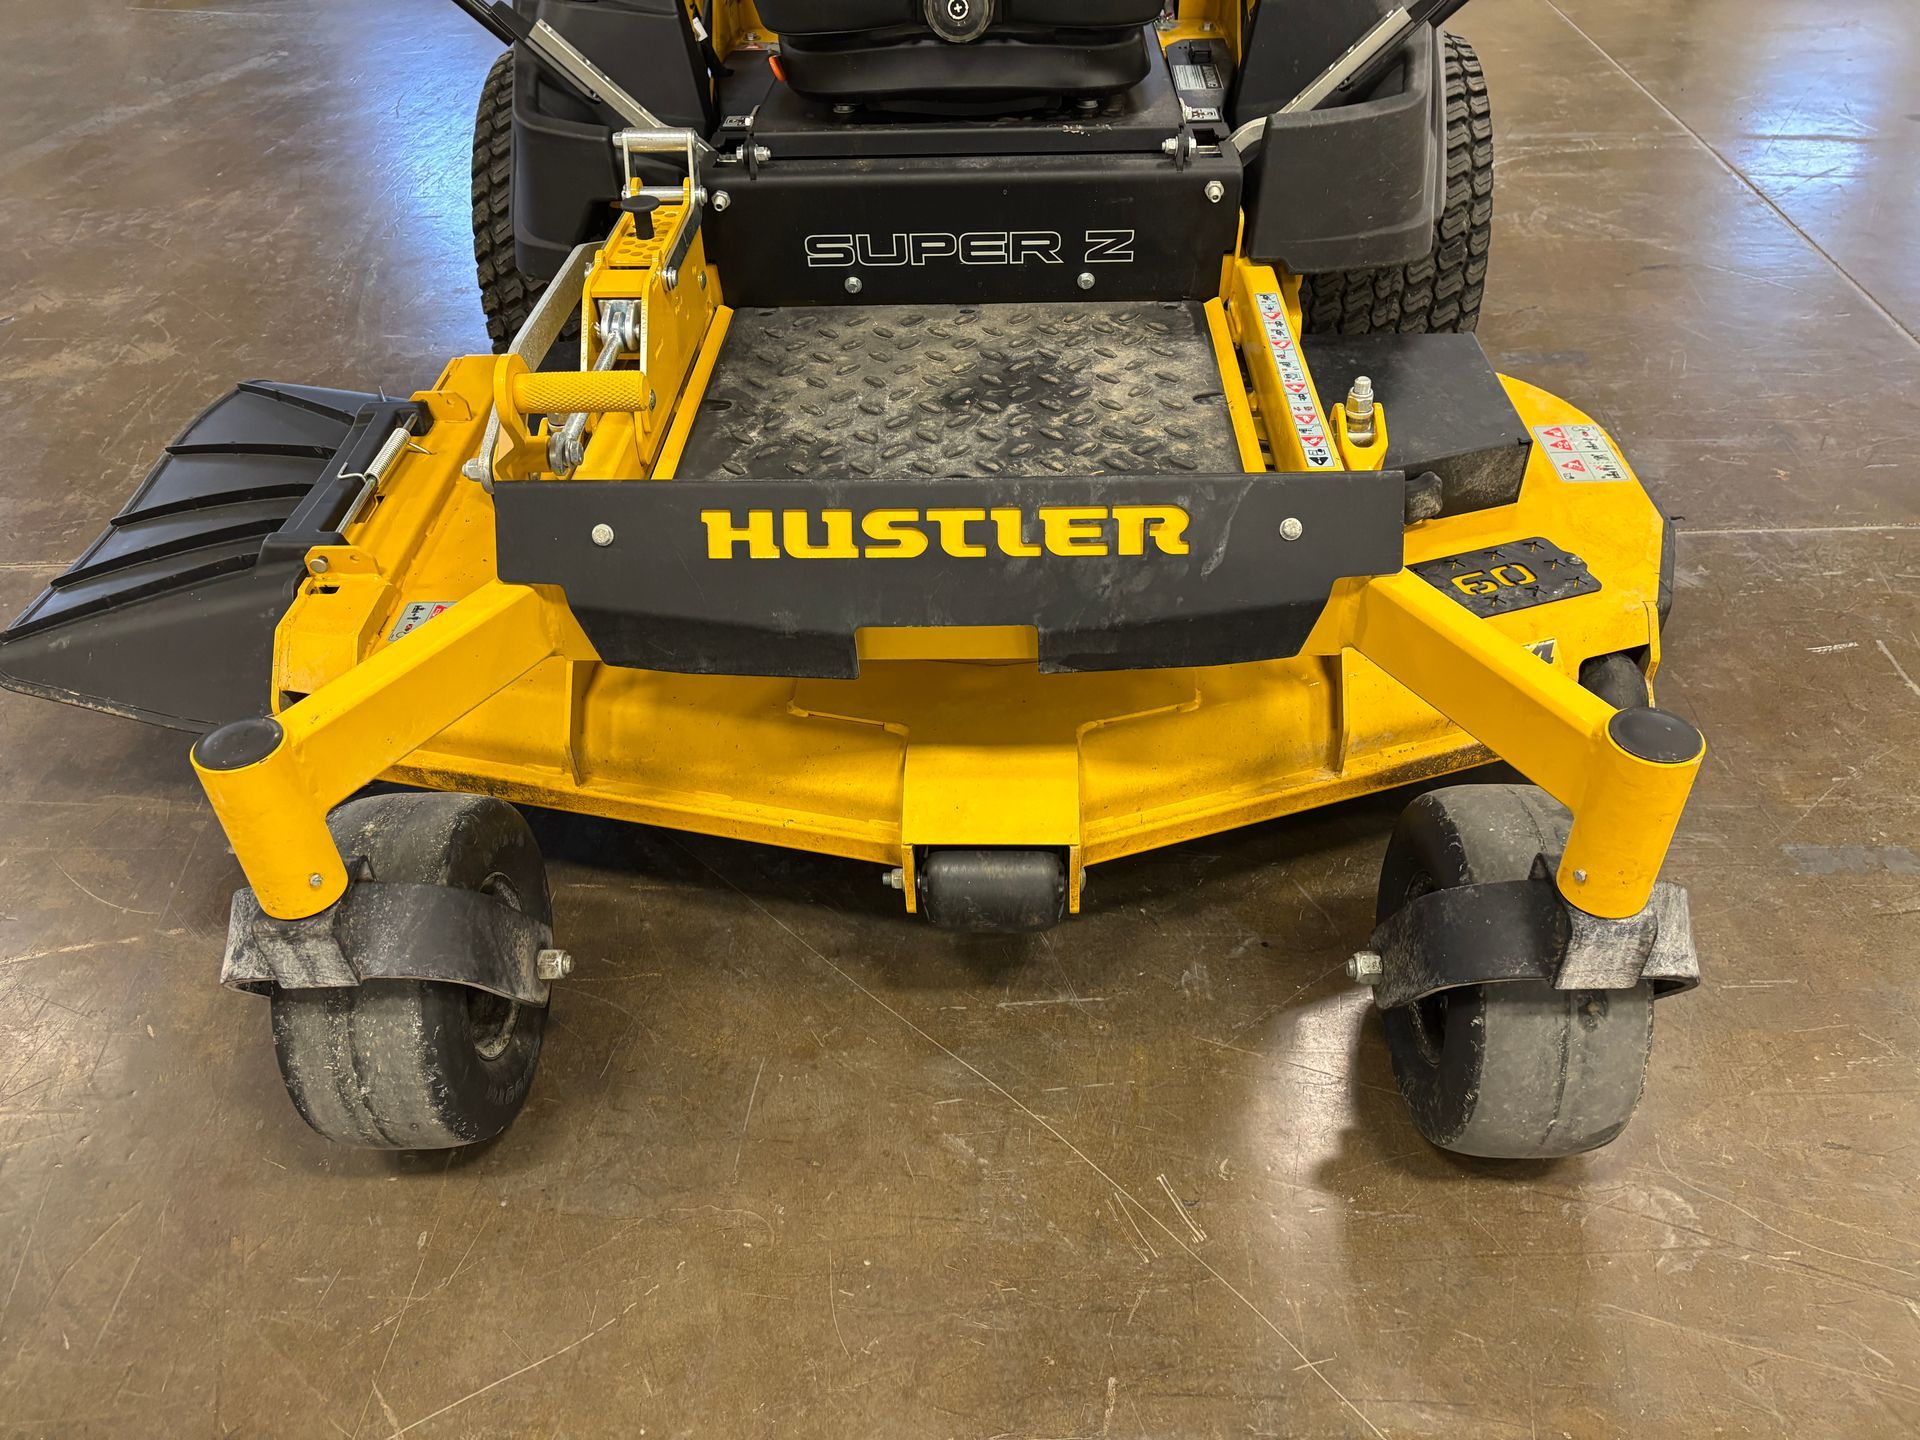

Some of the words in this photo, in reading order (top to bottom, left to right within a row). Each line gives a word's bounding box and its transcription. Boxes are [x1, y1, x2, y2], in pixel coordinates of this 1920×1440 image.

[805, 231, 1064, 266] SUPER
[1084, 229, 1135, 263] Z
[700, 505, 1191, 559] HUSTLER
[1451, 562, 1537, 596] 60
